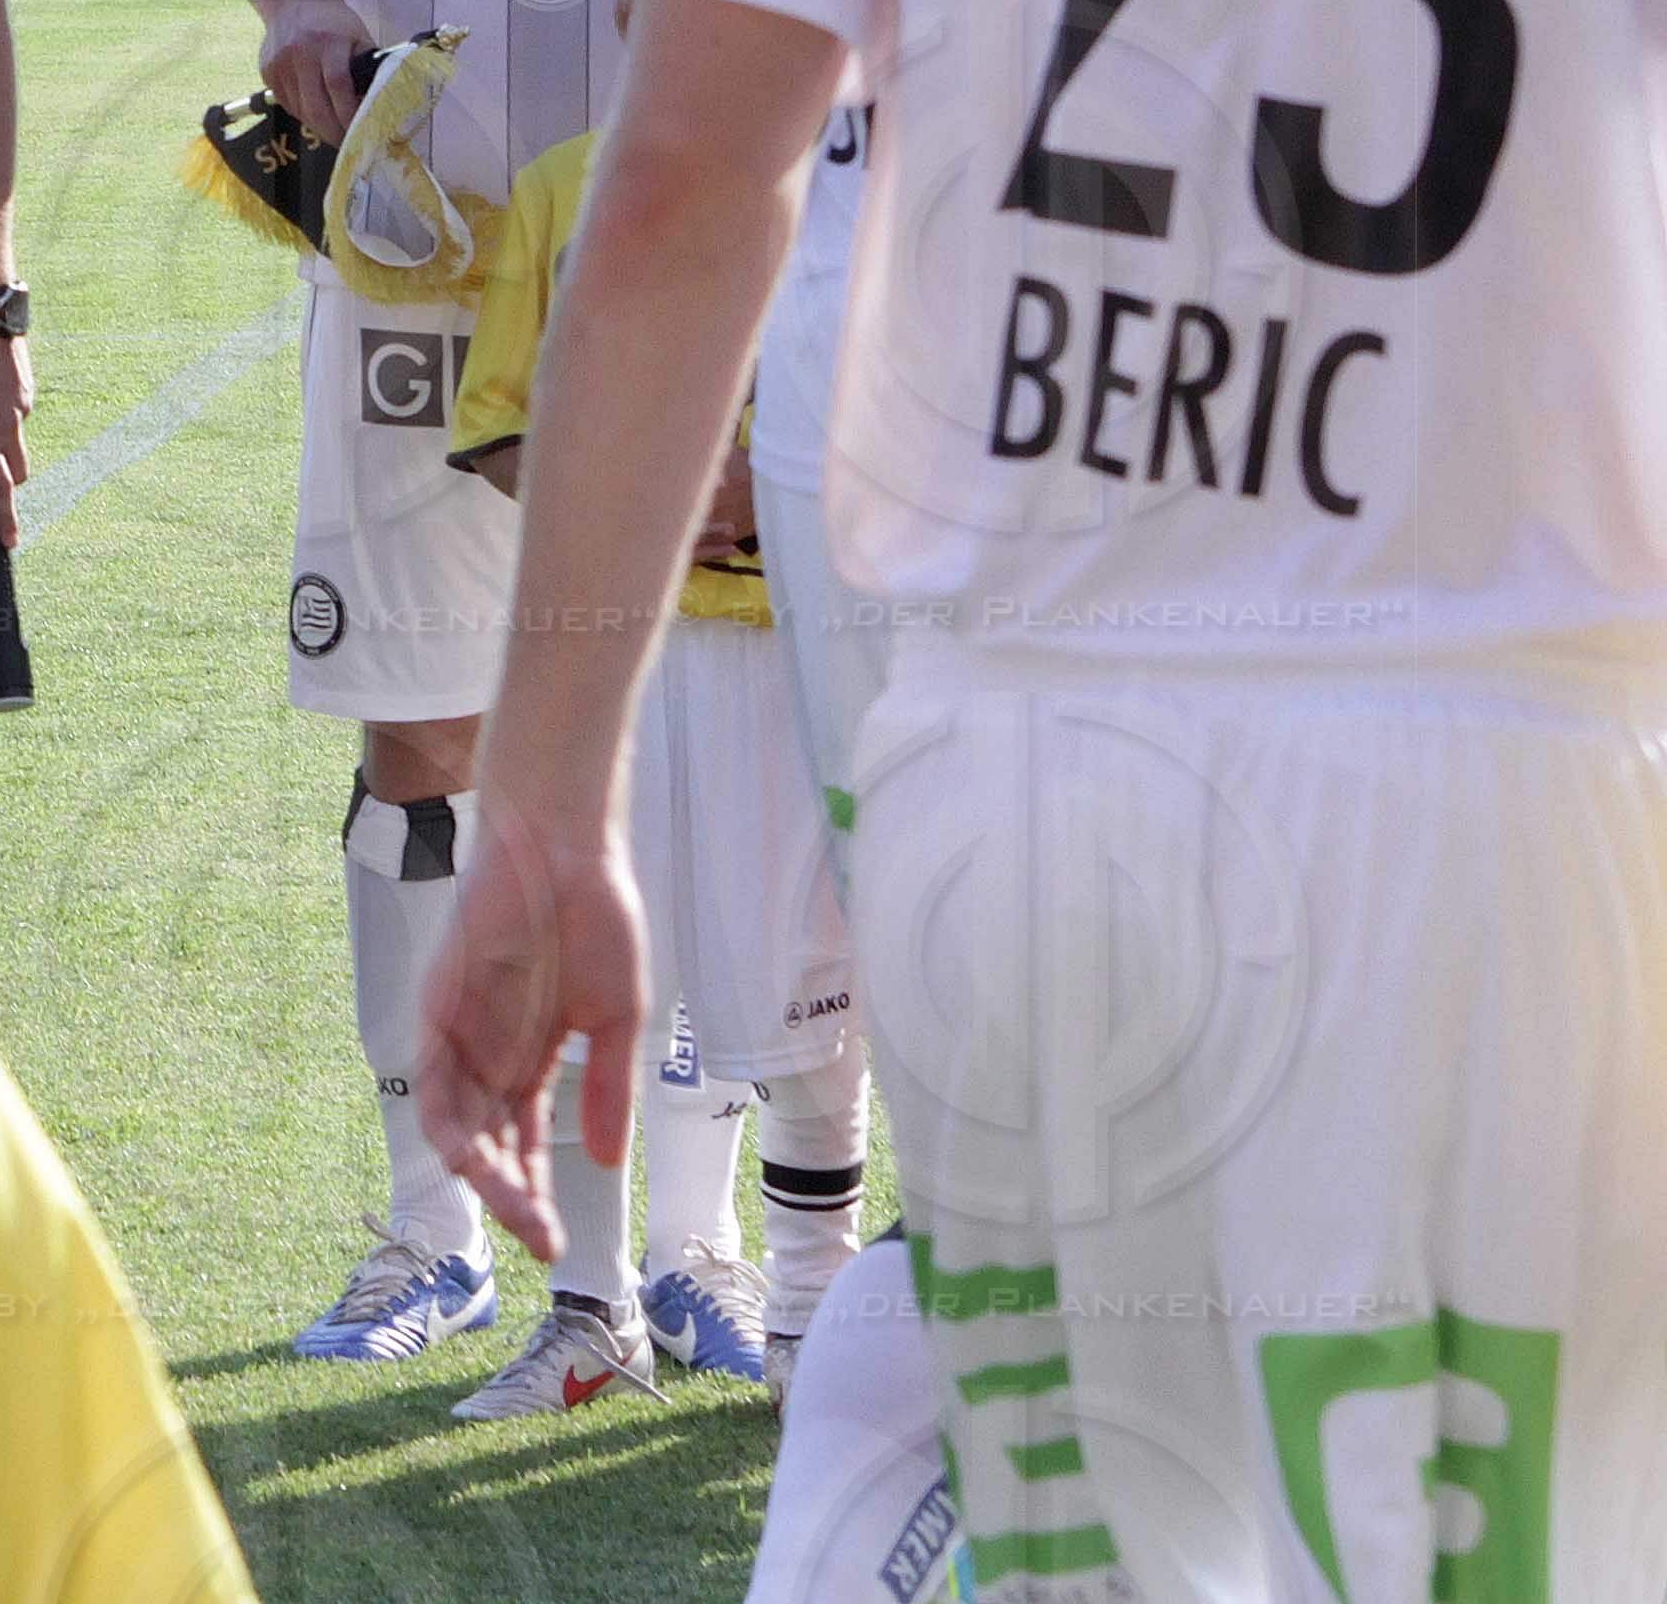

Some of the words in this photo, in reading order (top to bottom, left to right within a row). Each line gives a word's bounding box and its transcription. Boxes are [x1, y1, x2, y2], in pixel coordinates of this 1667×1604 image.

[254, 133, 298, 173] SK
[988, 278, 1387, 519] BERIC
[807, 992, 851, 1019] JAKO
